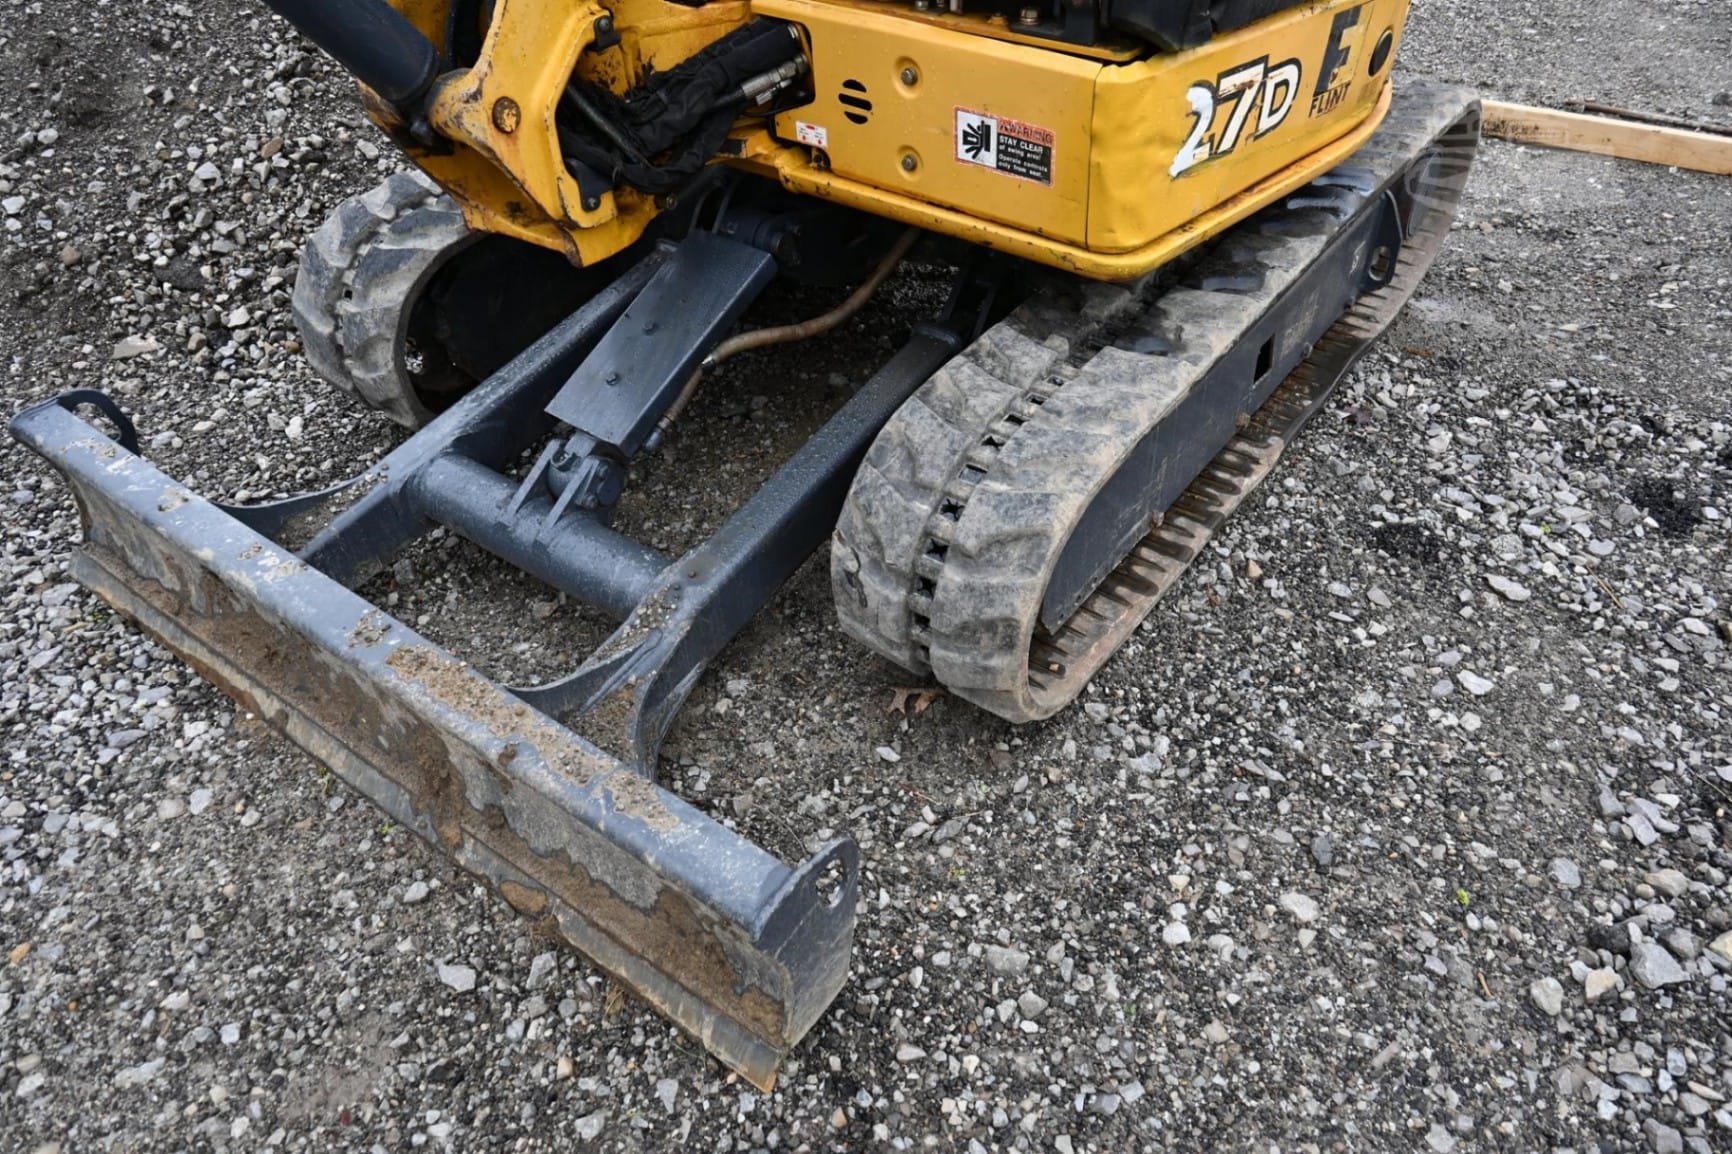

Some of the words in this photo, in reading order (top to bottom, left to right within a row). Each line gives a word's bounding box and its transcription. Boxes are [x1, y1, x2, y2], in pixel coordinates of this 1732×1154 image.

[1168, 54, 1303, 179] 27D
[1308, 81, 1352, 118] FLINT
[999, 135, 1018, 147] STAY
[1020, 141, 1043, 154] CLEAR
